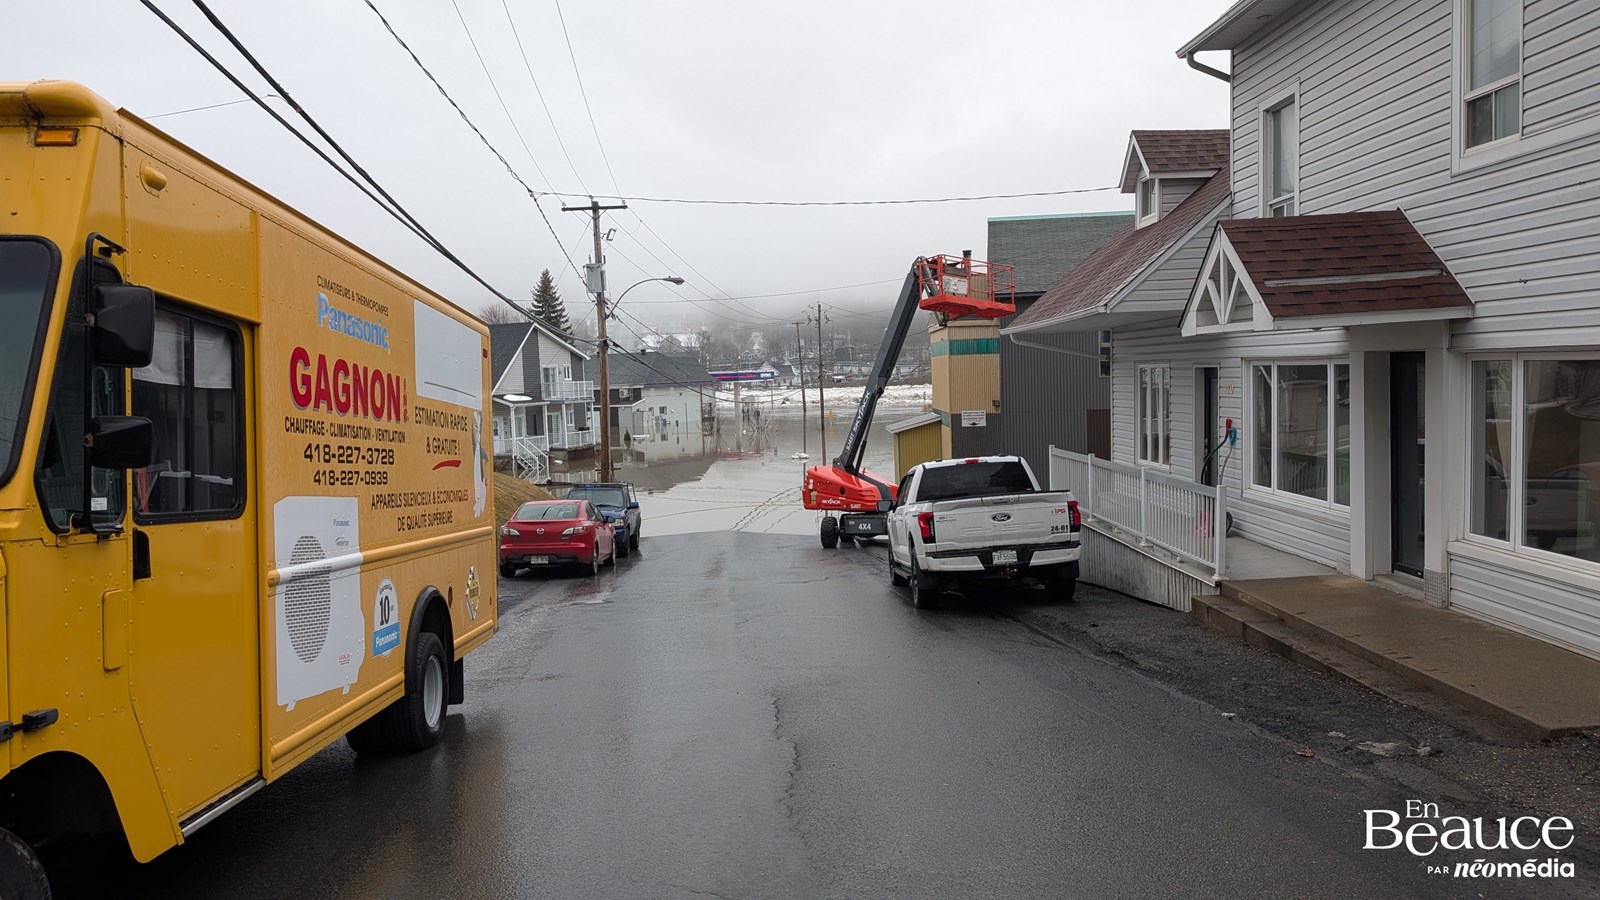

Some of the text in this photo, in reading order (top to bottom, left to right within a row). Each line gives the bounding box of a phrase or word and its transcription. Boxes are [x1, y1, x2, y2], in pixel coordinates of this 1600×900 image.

[317, 275, 389, 317] CLIMATISEURS & THERMOPOMPES
[317, 291, 389, 350] Panasonic
[290, 346, 401, 424] GAGNON
[284, 416, 325, 436] CHAUFFAGE
[329, 422, 372, 441] CLIMATISATION
[415, 406, 468, 432] ESTIMATION RAPIDE
[303, 443, 395, 465] 418-227-3728
[426, 437, 431, 454] &
[431, 437, 458, 456] GRATUITE
[313, 470, 388, 486] 418-227-0939
[371, 493, 402, 510] APPAREILS
[403, 491, 432, 508] SILENCIEUX
[437, 487, 469, 505] ÉCONOMIQUES
[397, 508, 453, 532] DE QUALITÉ SUPÉRIEURE
[858, 523, 872, 531] 4X4
[379, 595, 391, 626] 10
[375, 631, 397, 648] Panasonic
